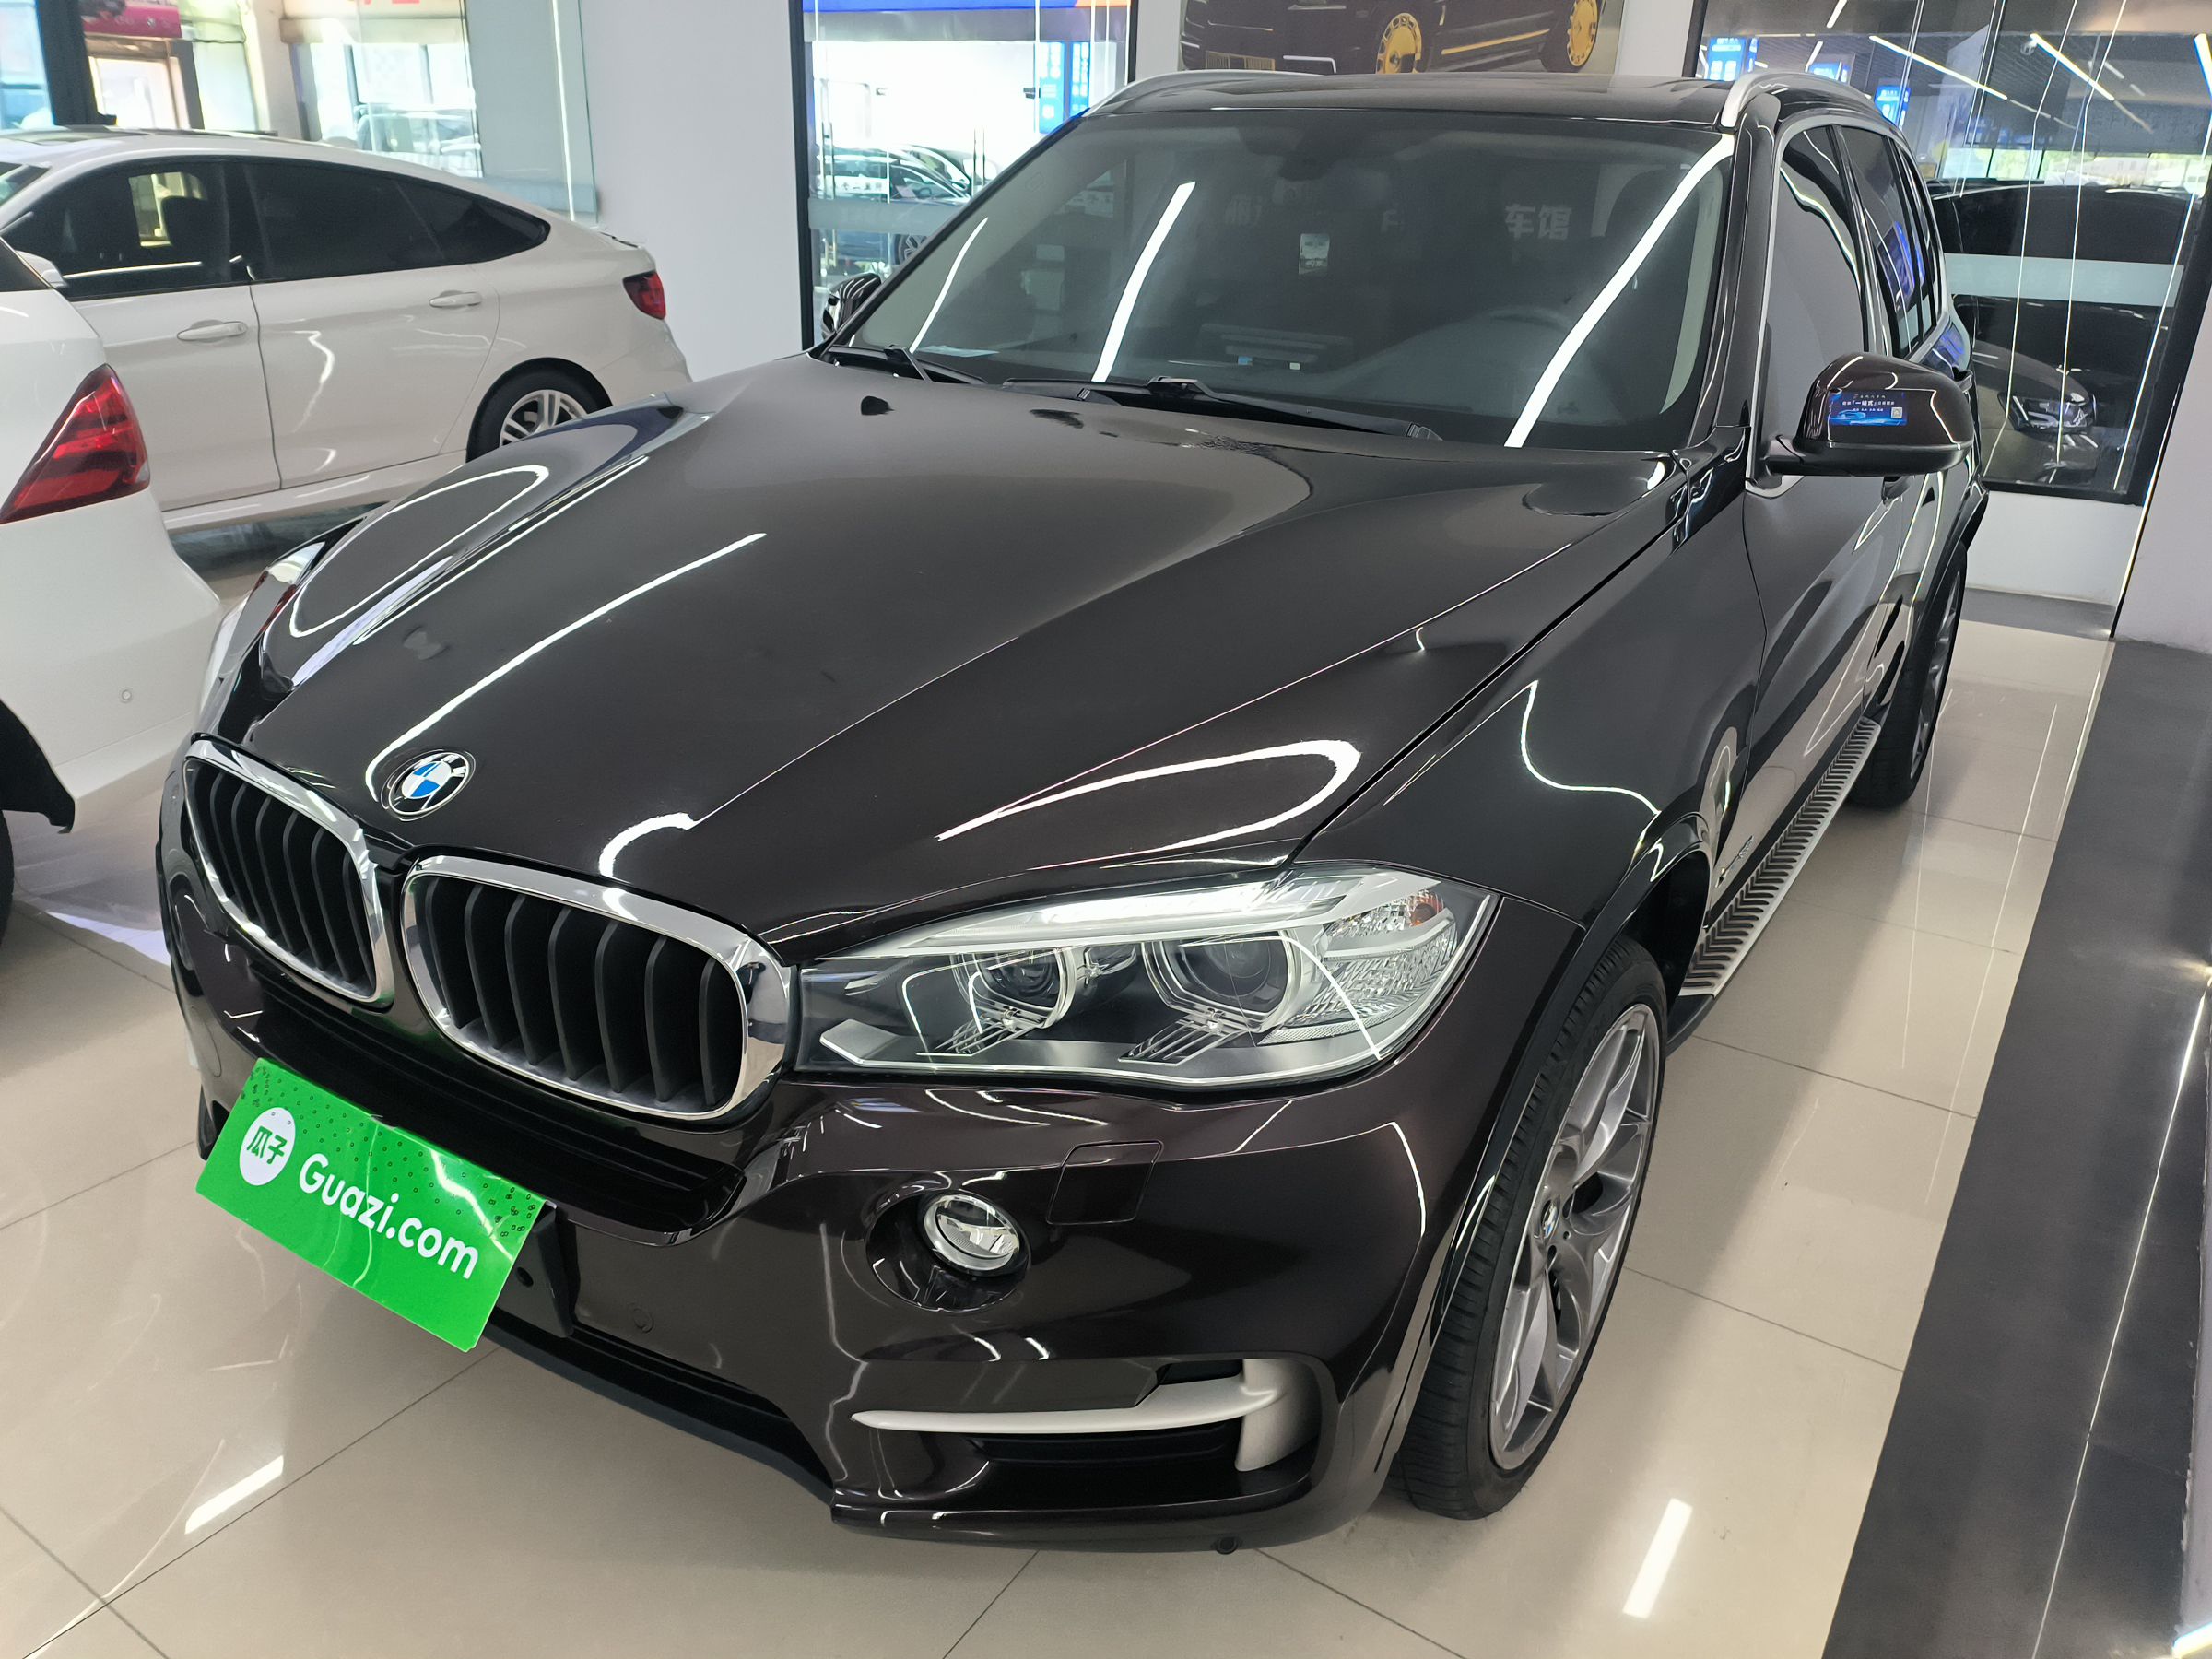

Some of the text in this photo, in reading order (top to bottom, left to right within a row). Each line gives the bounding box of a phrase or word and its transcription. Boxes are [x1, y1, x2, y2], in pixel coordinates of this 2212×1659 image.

[1505, 203, 1572, 241] 车馆
[246, 1125, 288, 1164] 瓜子
[299, 1153, 479, 1280] Guazi.com
